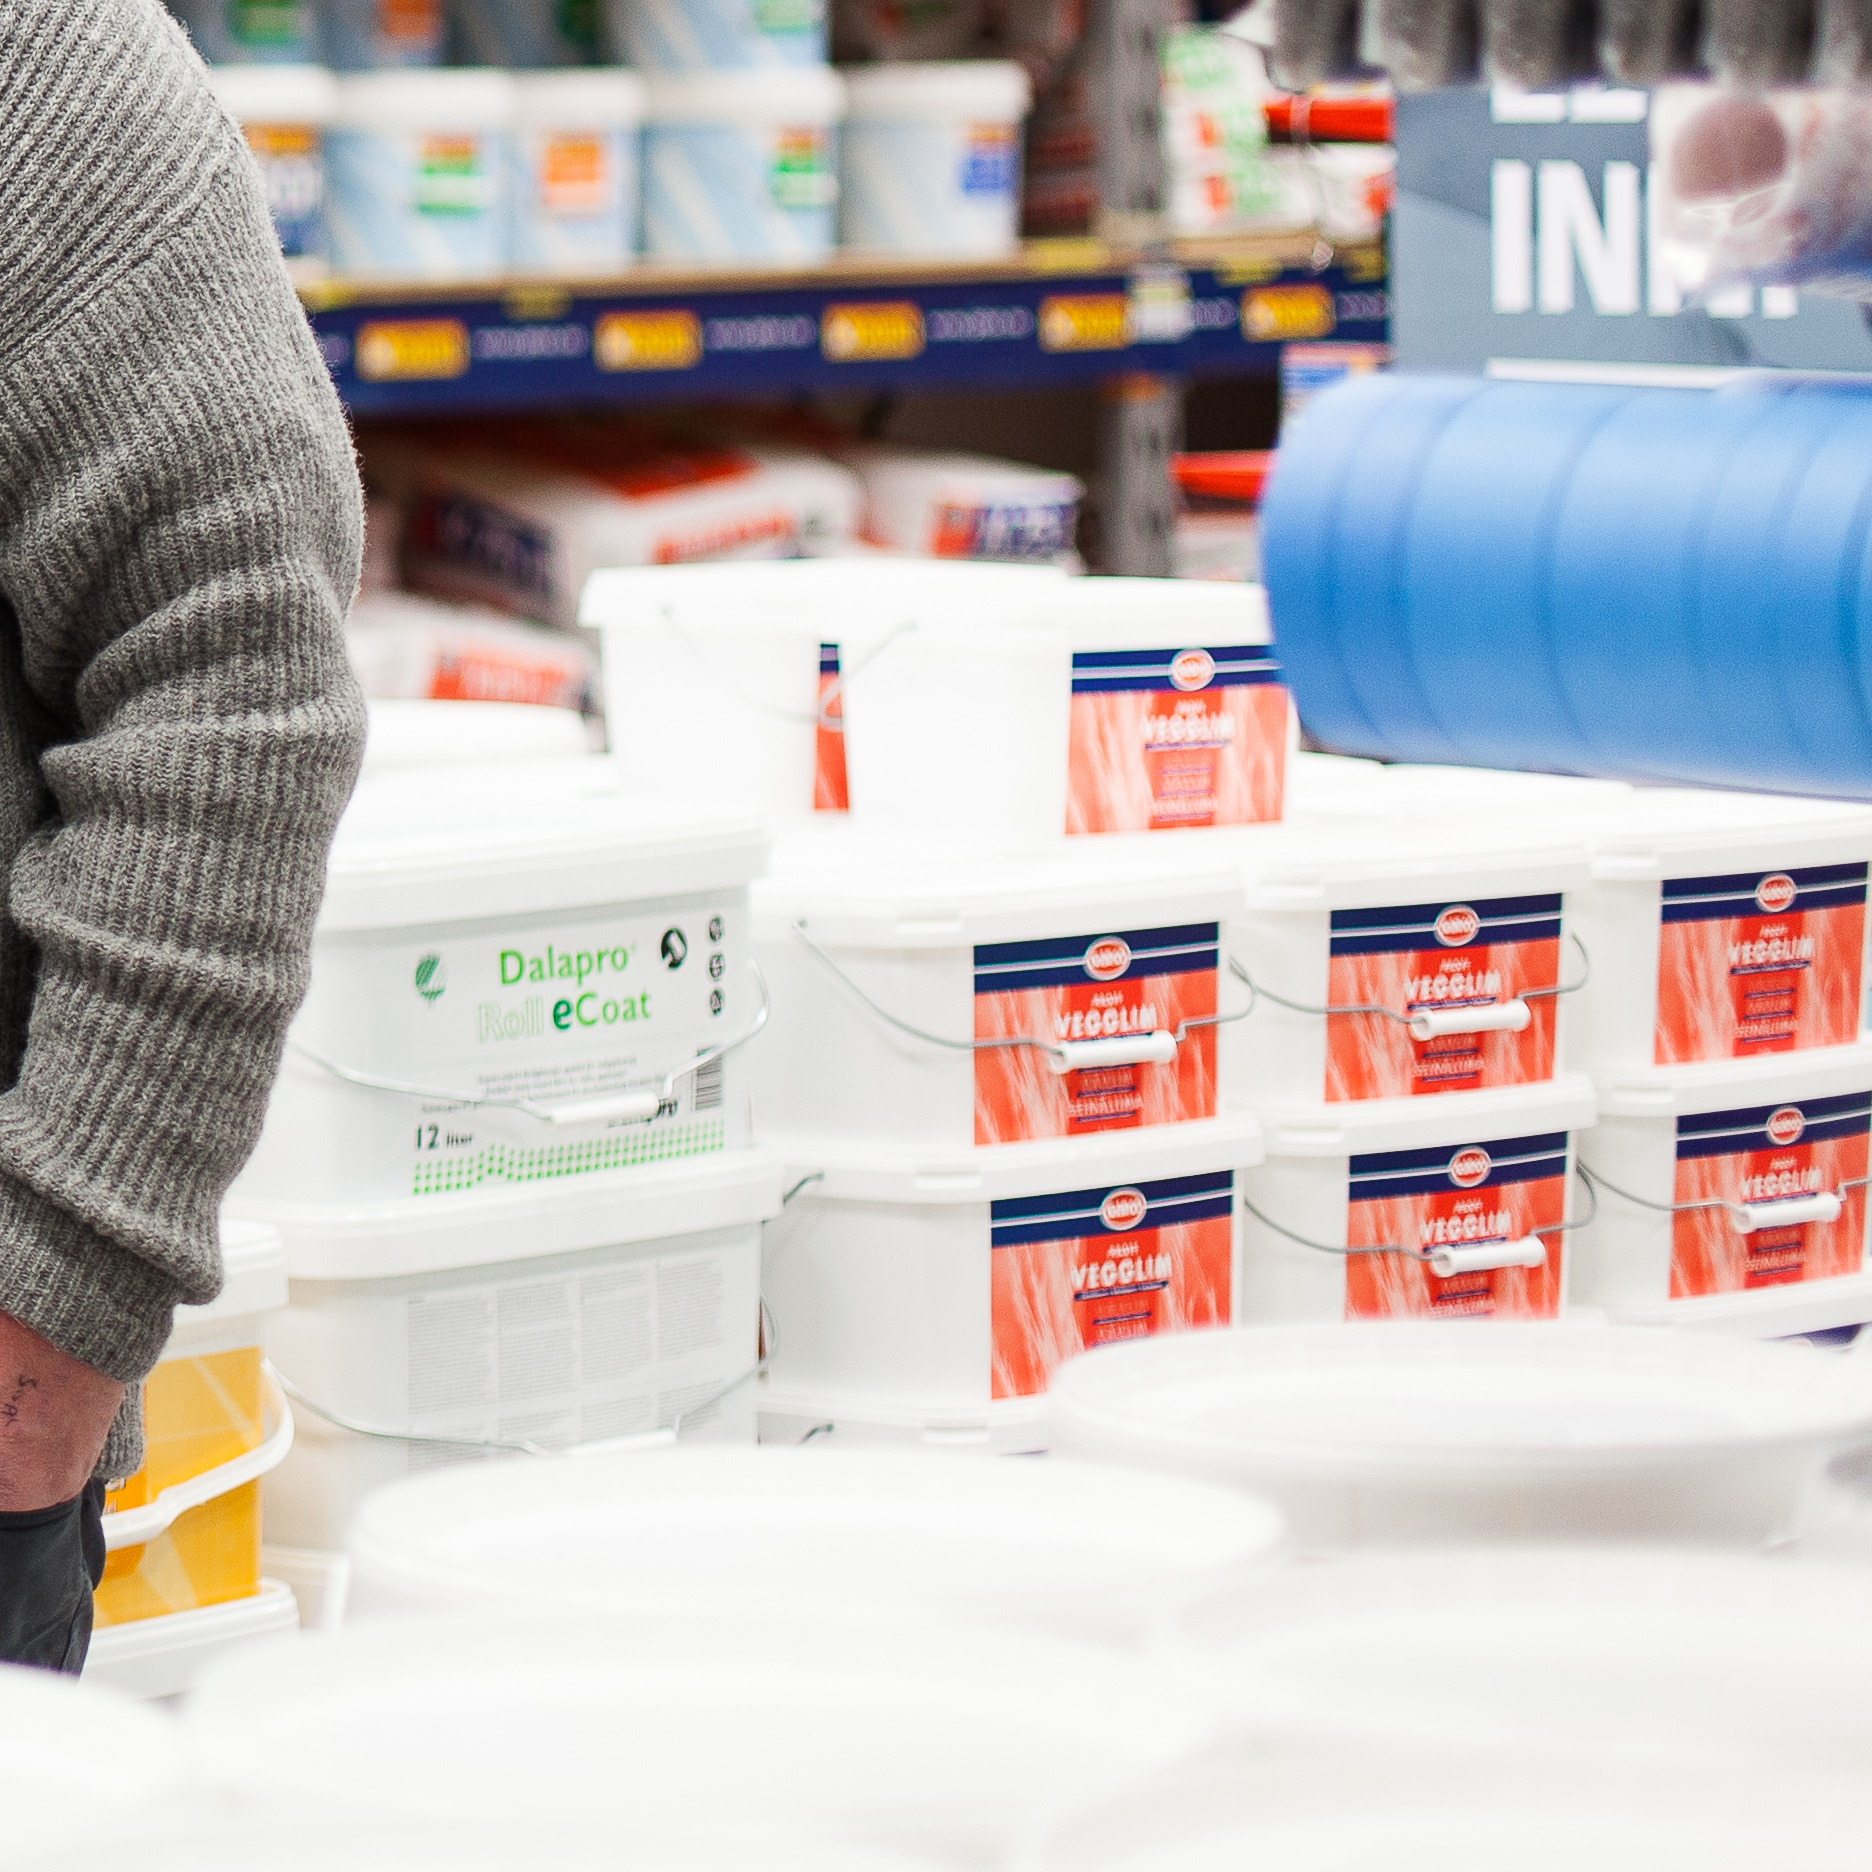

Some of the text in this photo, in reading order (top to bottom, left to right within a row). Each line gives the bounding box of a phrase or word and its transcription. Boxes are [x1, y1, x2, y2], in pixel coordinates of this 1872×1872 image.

[499, 944, 630, 988] Dalapro
[477, 988, 653, 1044] Roll eCoat
[415, 1124, 440, 1151] 12
